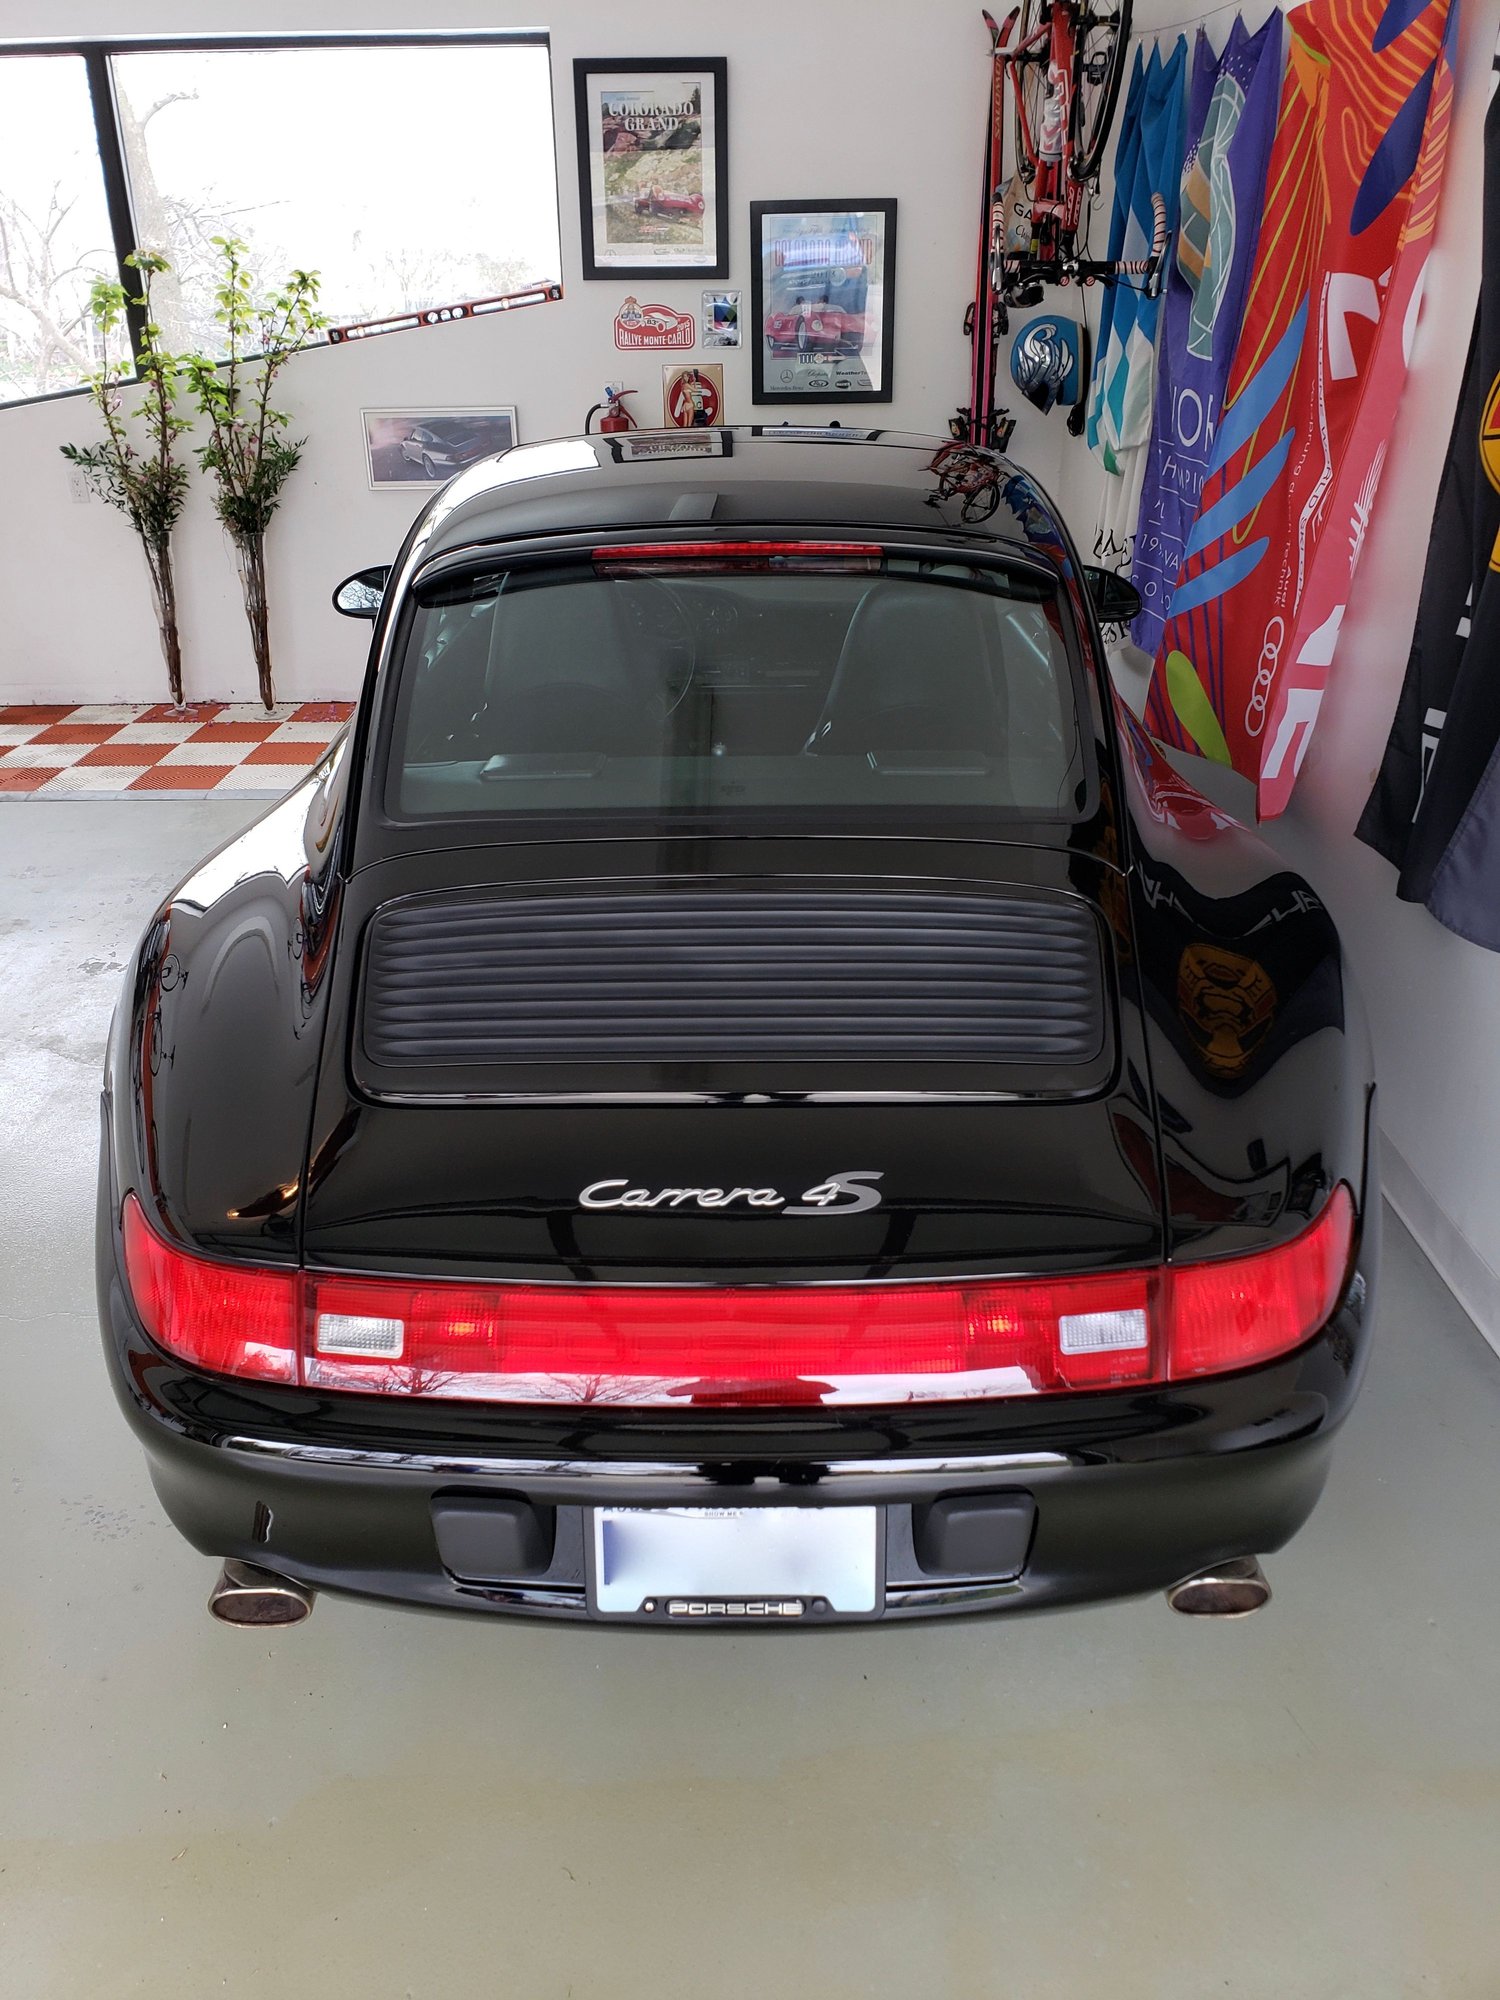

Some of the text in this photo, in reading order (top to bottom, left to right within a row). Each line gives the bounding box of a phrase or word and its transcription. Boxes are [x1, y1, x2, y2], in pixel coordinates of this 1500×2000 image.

[608, 101, 694, 116] COLORADO
[624, 117, 679, 131] GRAND
[676, 320, 690, 331] 2015
[619, 328, 642, 346] RALLYE
[1279, 566, 1292, 608] Audi
[578, 1170, 885, 1215] Carrera 4S
[669, 1602, 803, 1615] PORSCHE
